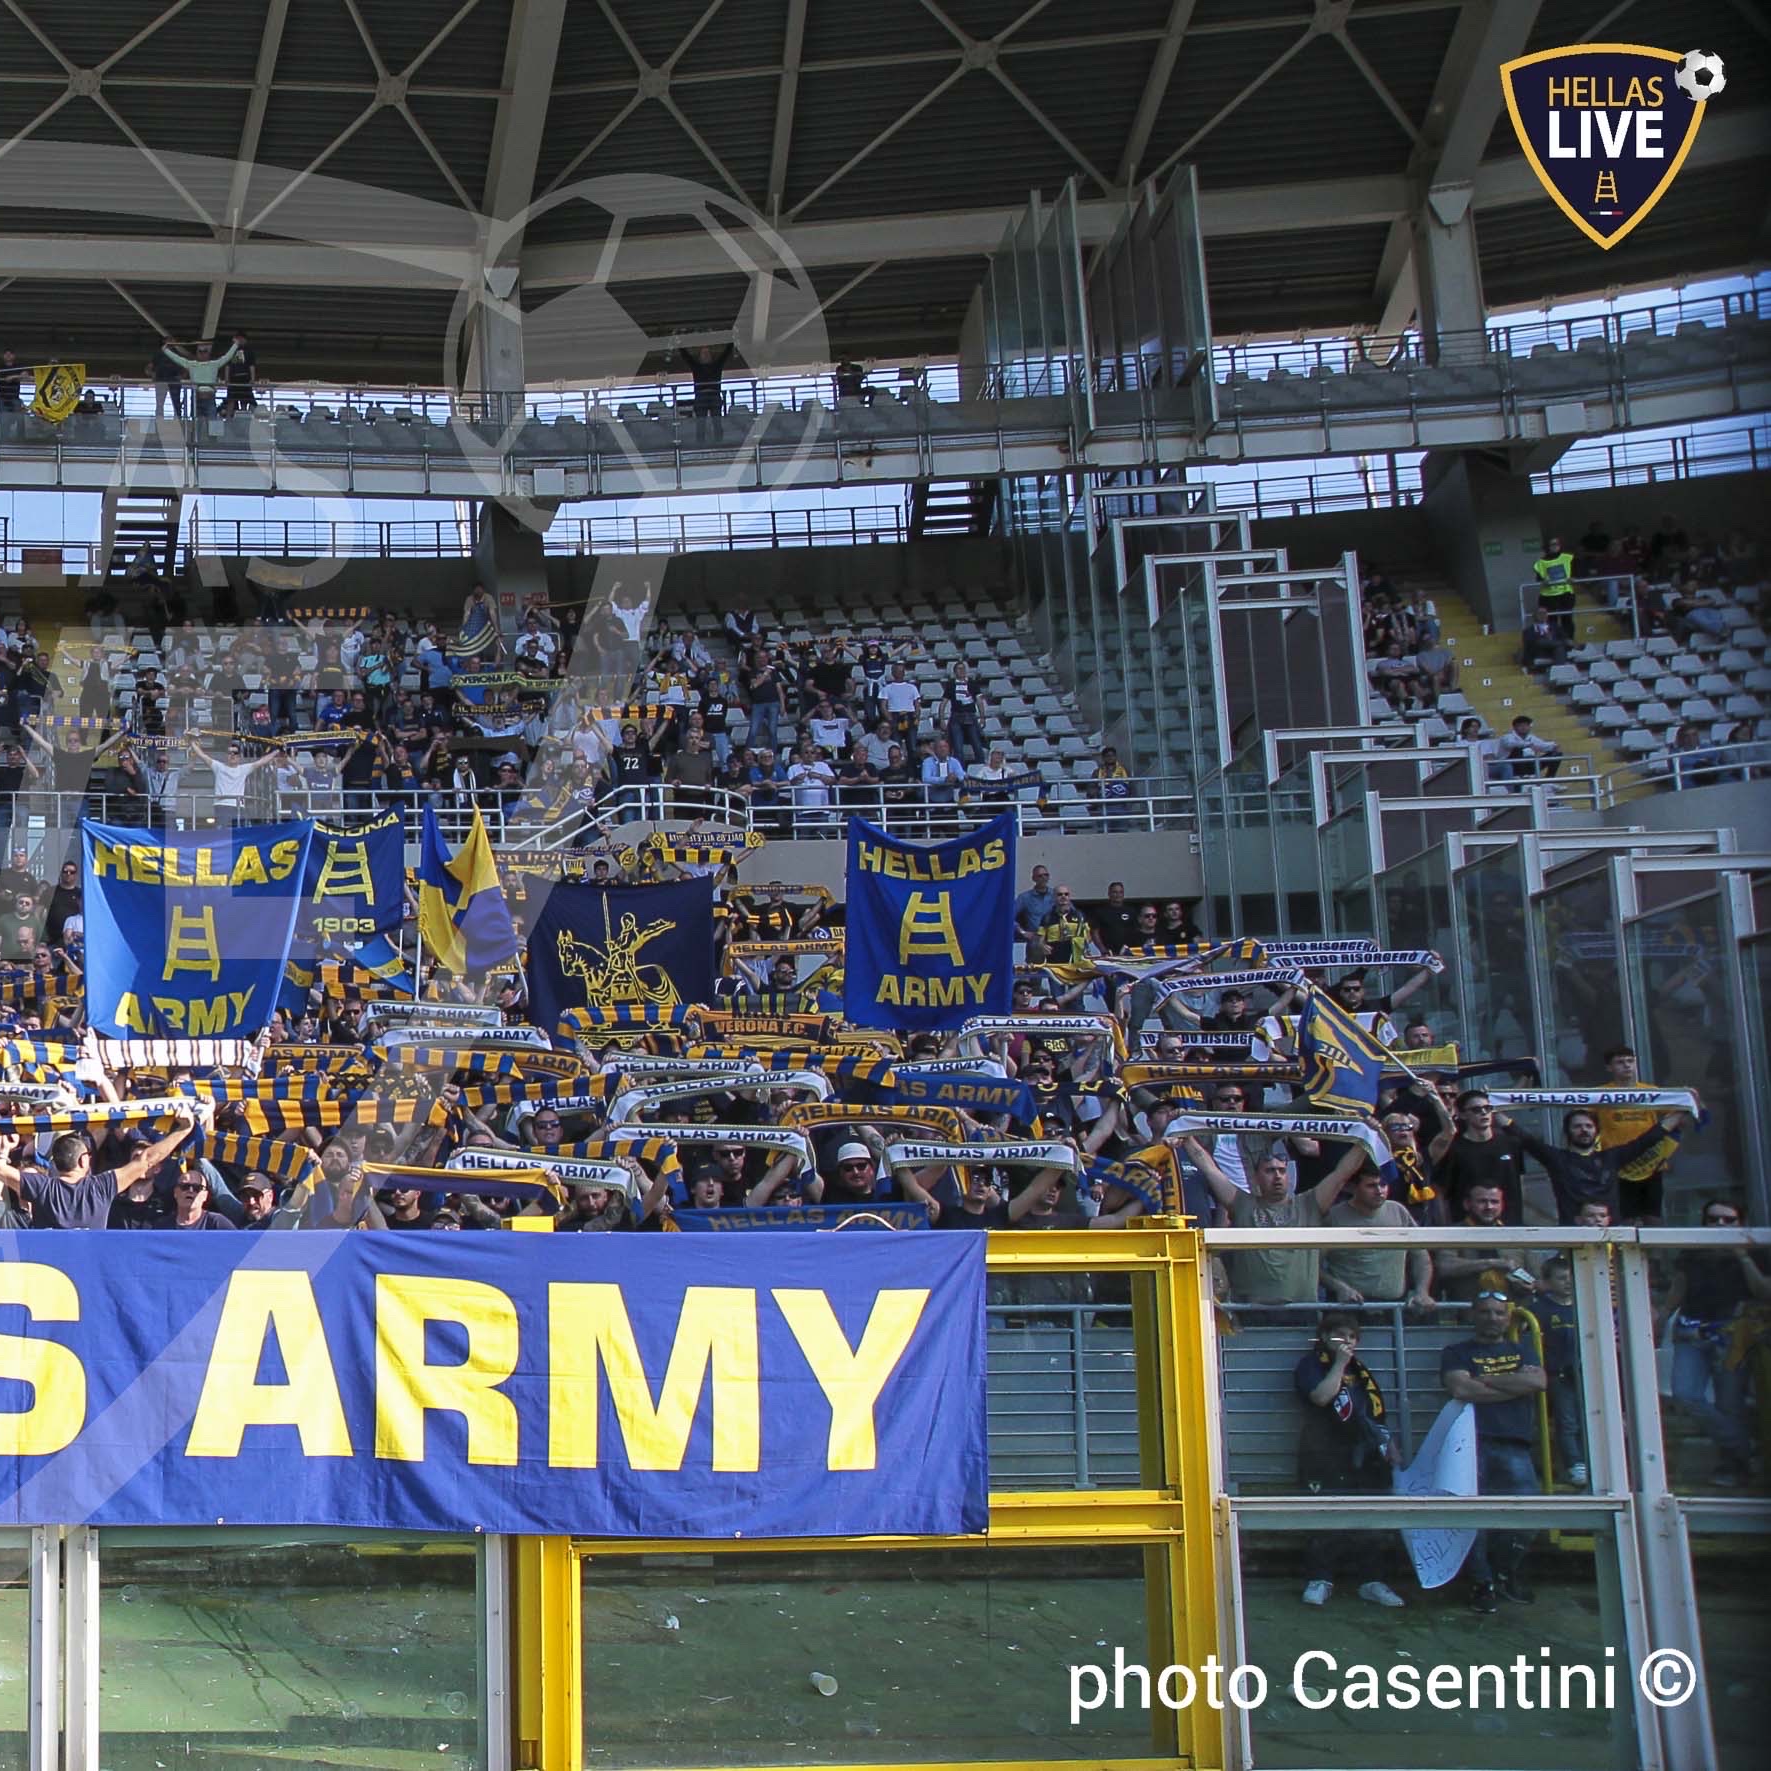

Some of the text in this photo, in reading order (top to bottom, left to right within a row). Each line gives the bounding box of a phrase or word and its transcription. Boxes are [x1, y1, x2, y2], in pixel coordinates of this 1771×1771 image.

[623, 757, 639, 769] 72
[313, 811, 400, 837] ERONA
[94, 838, 300, 887] HELLAS
[858, 838, 1007, 881] HELLAS
[312, 917, 376, 933] 1903
[1296, 955, 1338, 967] CREDO
[876, 973, 992, 1007] ARMY
[114, 984, 256, 1038] ARMY
[371, 1003, 483, 1021] HELLAS ARMY
[714, 1020, 777, 1033] VERONA
[1038, 1018, 1096, 1028] ARMY
[409, 1030, 532, 1042] HELLAS ARMY
[1200, 1034, 1255, 1045] RISORGE
[527, 1054, 579, 1073] ARM
[616, 1061, 752, 1073] HELLAS ARMY
[930, 1060, 984, 1072] ARMY
[645, 1072, 797, 1098] HELLAS ARMY
[936, 1083, 1021, 1105] ARMY
[1509, 1093, 1661, 1104] HELLAS ARMY
[792, 1103, 959, 1134] HELLAS ARM
[1205, 1117, 1354, 1134] HELLAS ARMY
[638, 1128, 793, 1143] HELLAS ARMY
[904, 1145, 1053, 1158] HELLAS ARMY
[461, 1154, 612, 1181] HELLAS ARMY
[707, 1208, 924, 1231] HELLAS ARMY
[184, 1268, 932, 1473] ARMY
